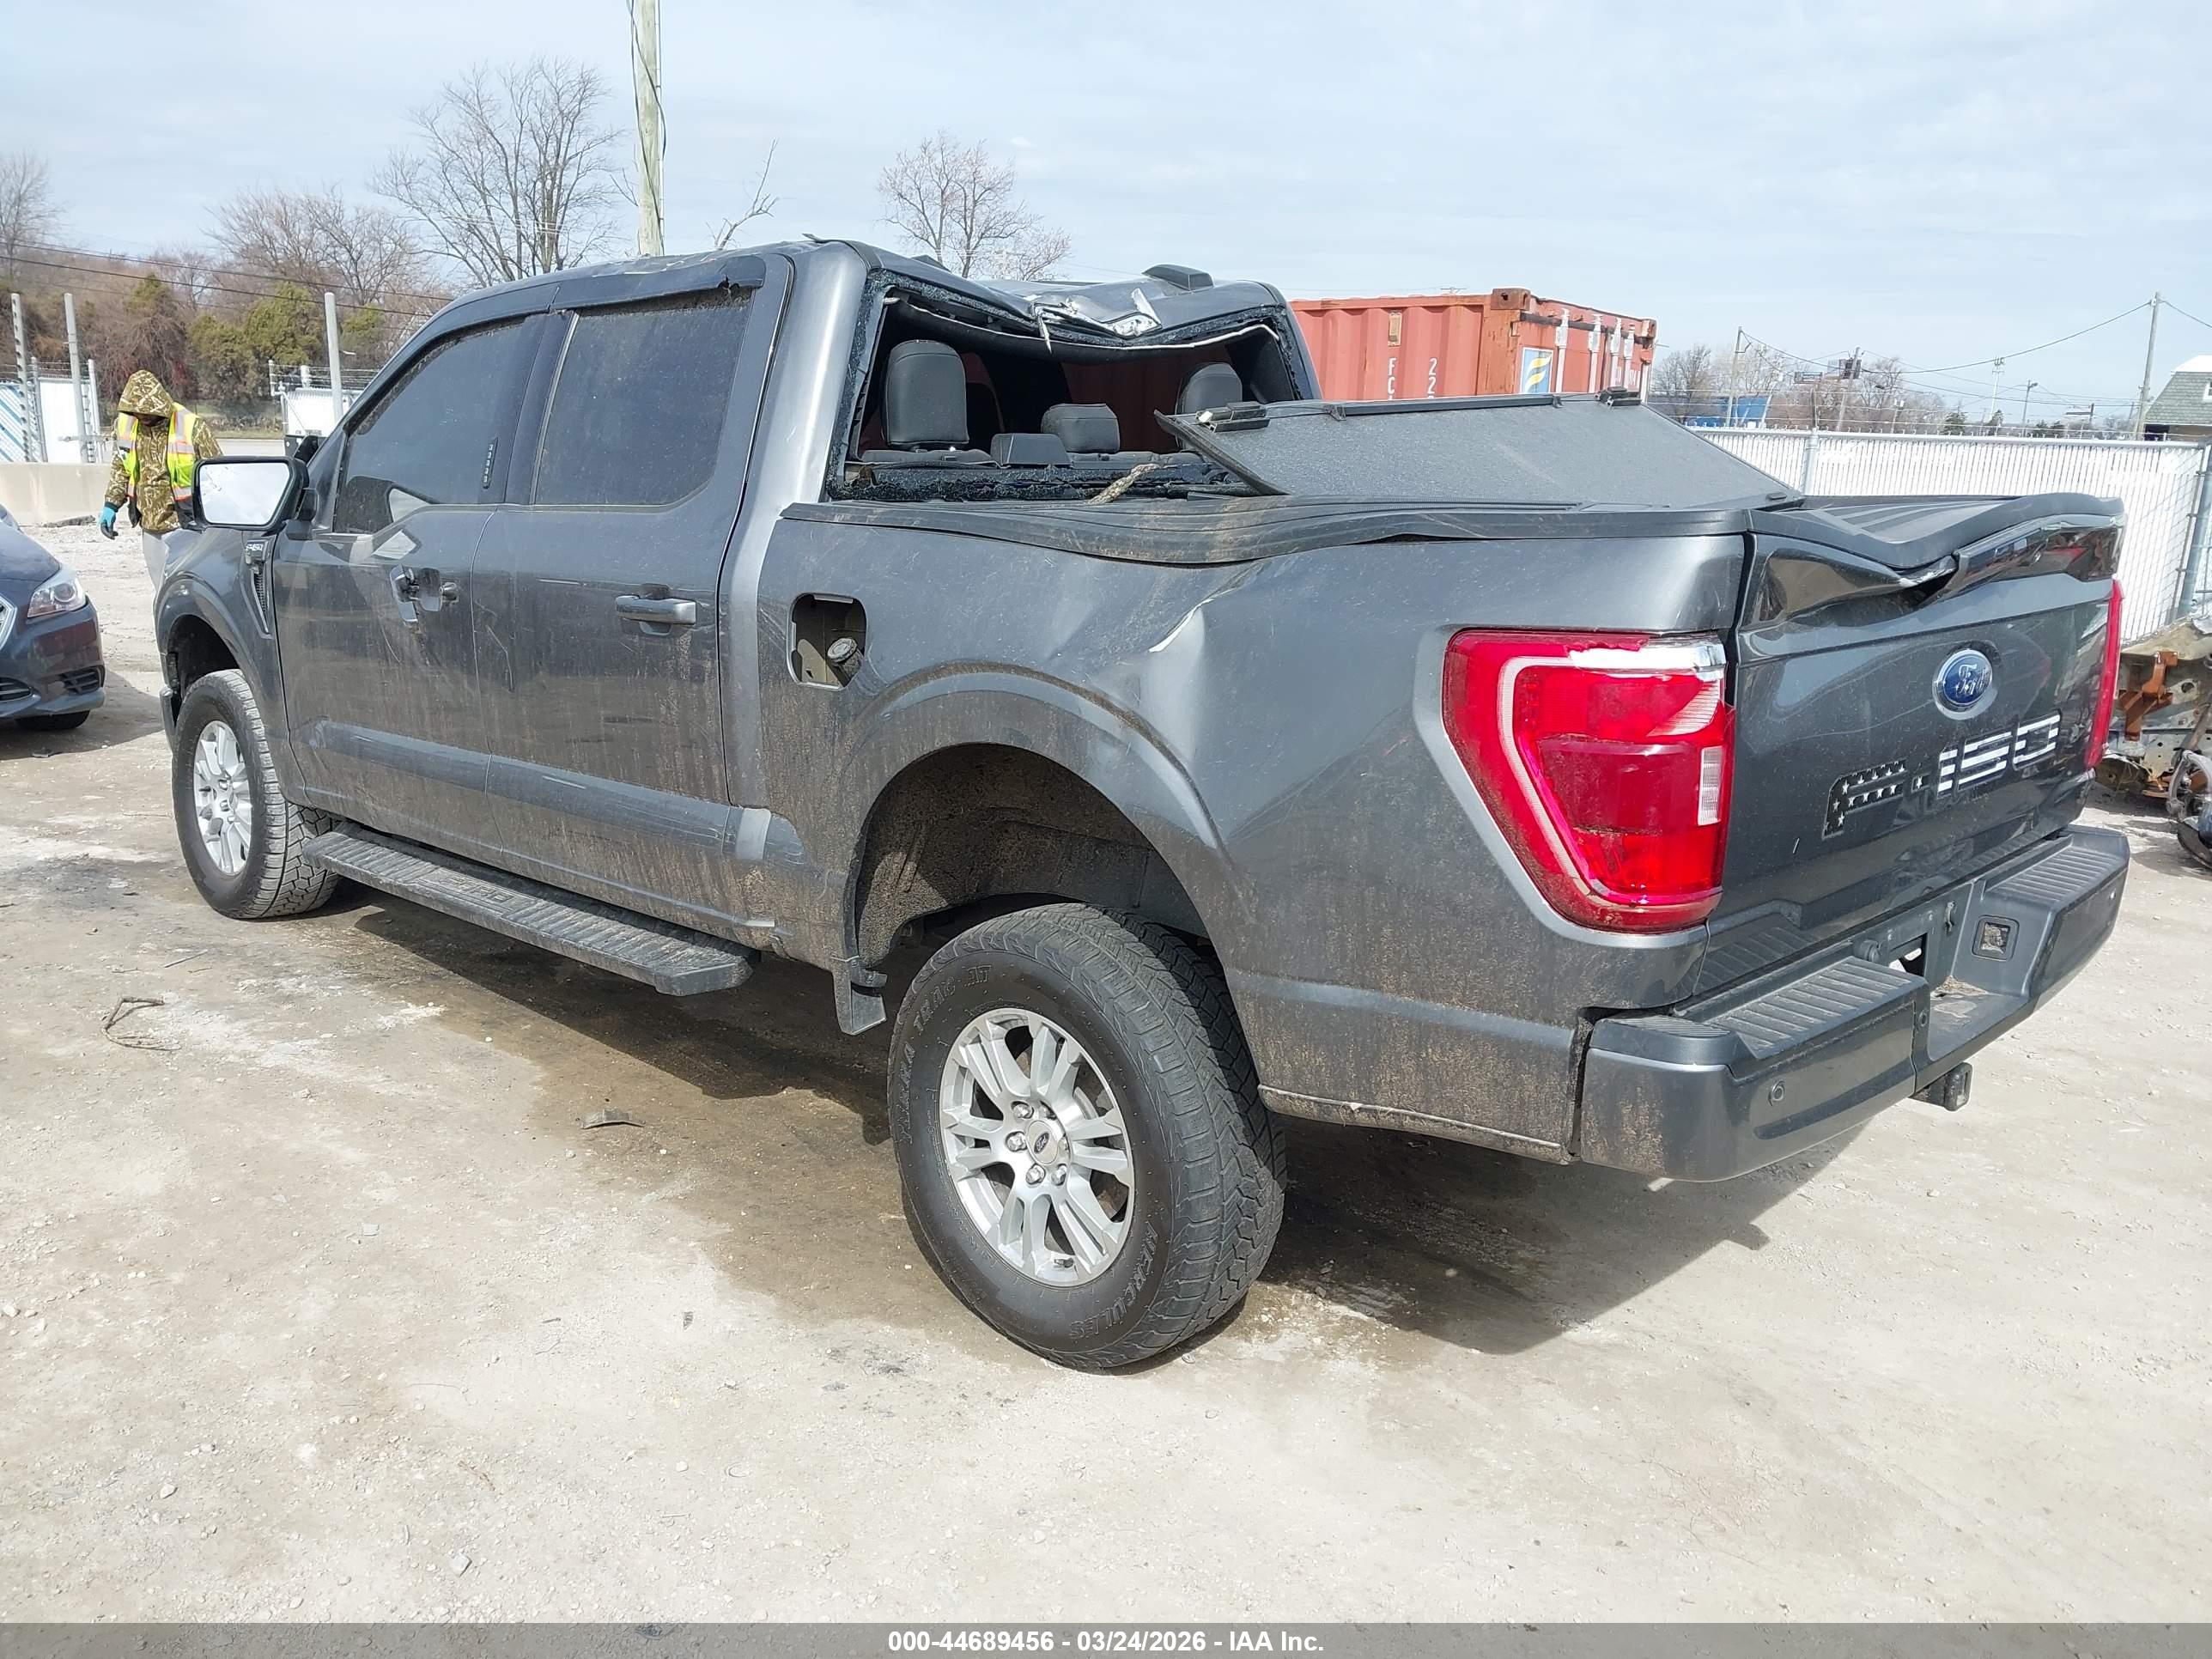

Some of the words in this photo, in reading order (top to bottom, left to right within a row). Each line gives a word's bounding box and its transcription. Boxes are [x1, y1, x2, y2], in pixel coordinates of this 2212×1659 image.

[1388, 357, 1397, 400] FC
[1427, 357, 1437, 399] 22
[1822, 711, 2061, 839] F-150
[1035, 1133, 1048, 1152] Ford
[1069, 1220, 1158, 1339] HERCULES
